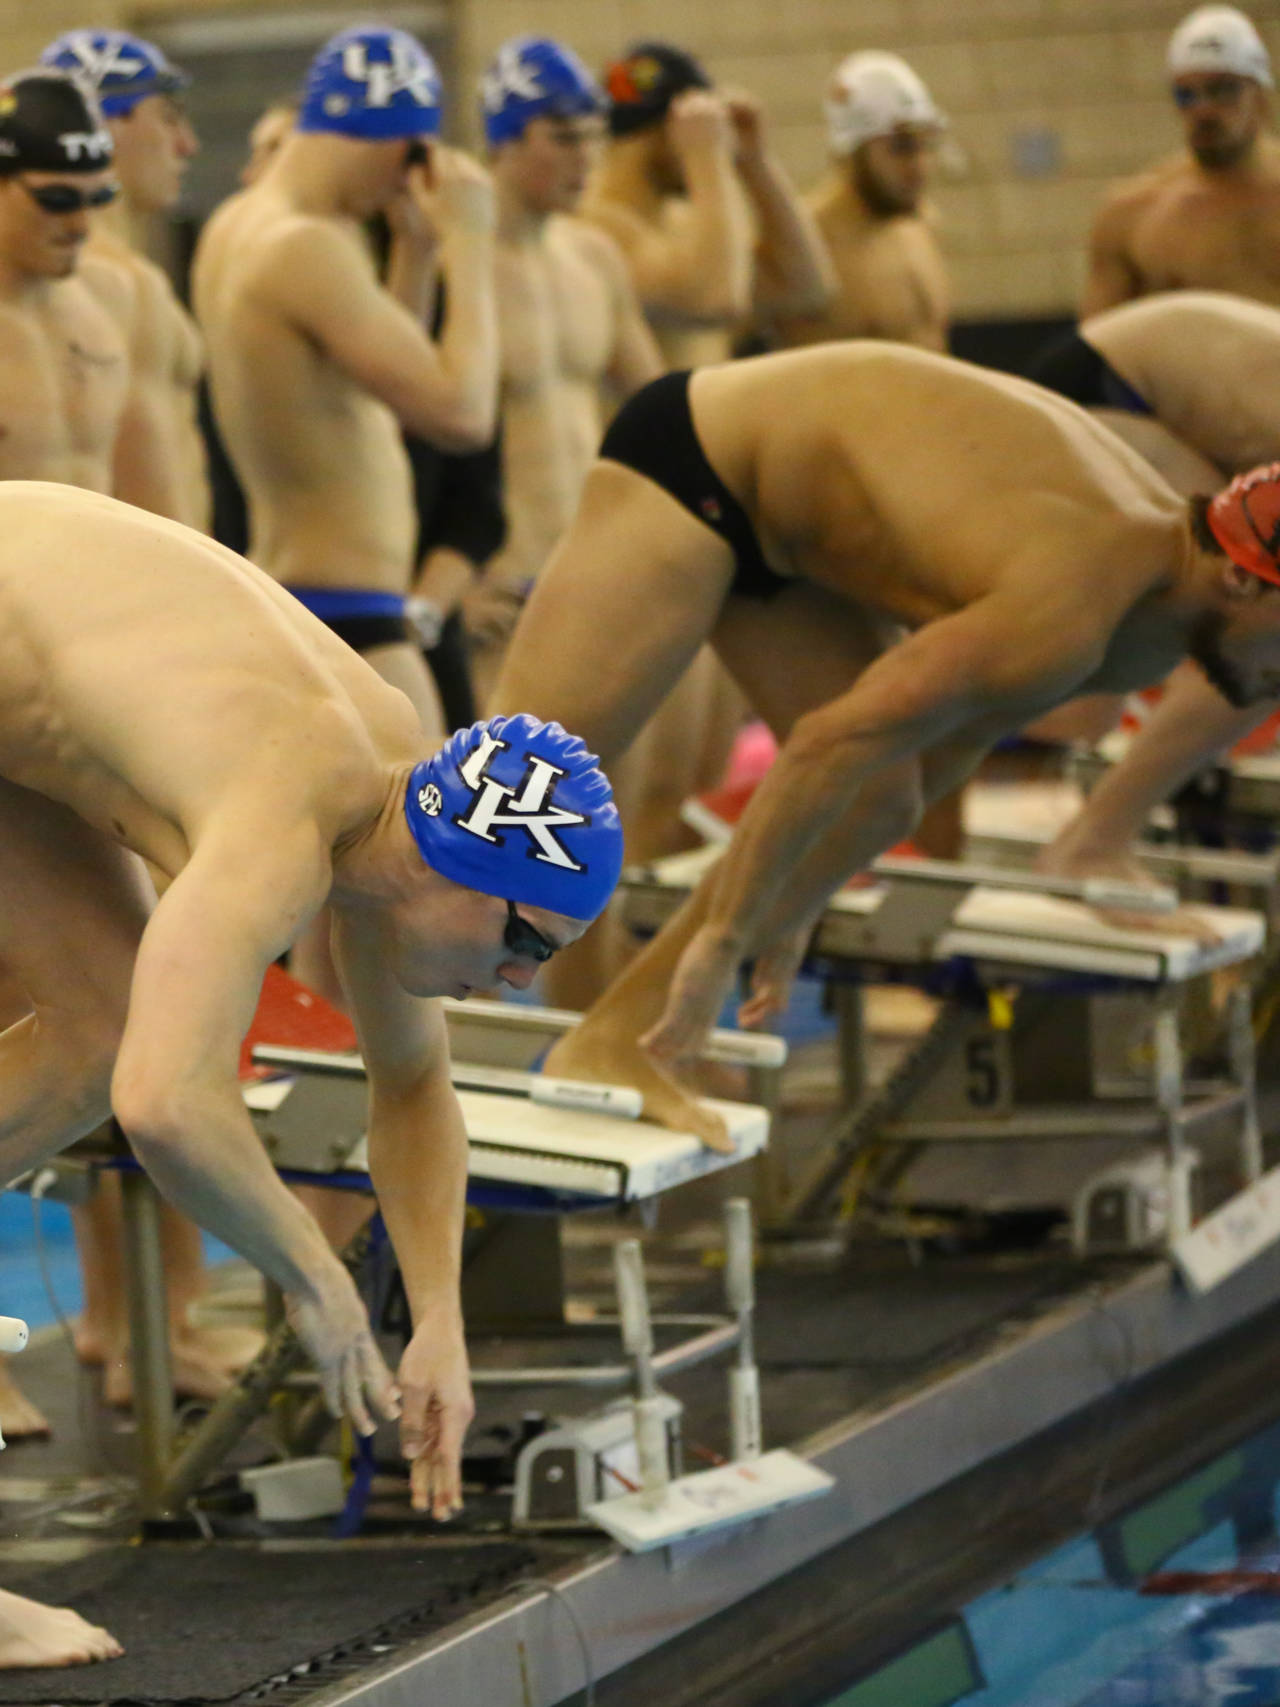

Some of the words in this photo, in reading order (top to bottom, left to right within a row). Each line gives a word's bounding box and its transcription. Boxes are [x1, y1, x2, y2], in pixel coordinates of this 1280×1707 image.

[418, 783, 443, 818] SEC
[455, 730, 586, 873] UK
[966, 1038, 998, 1107] 5
